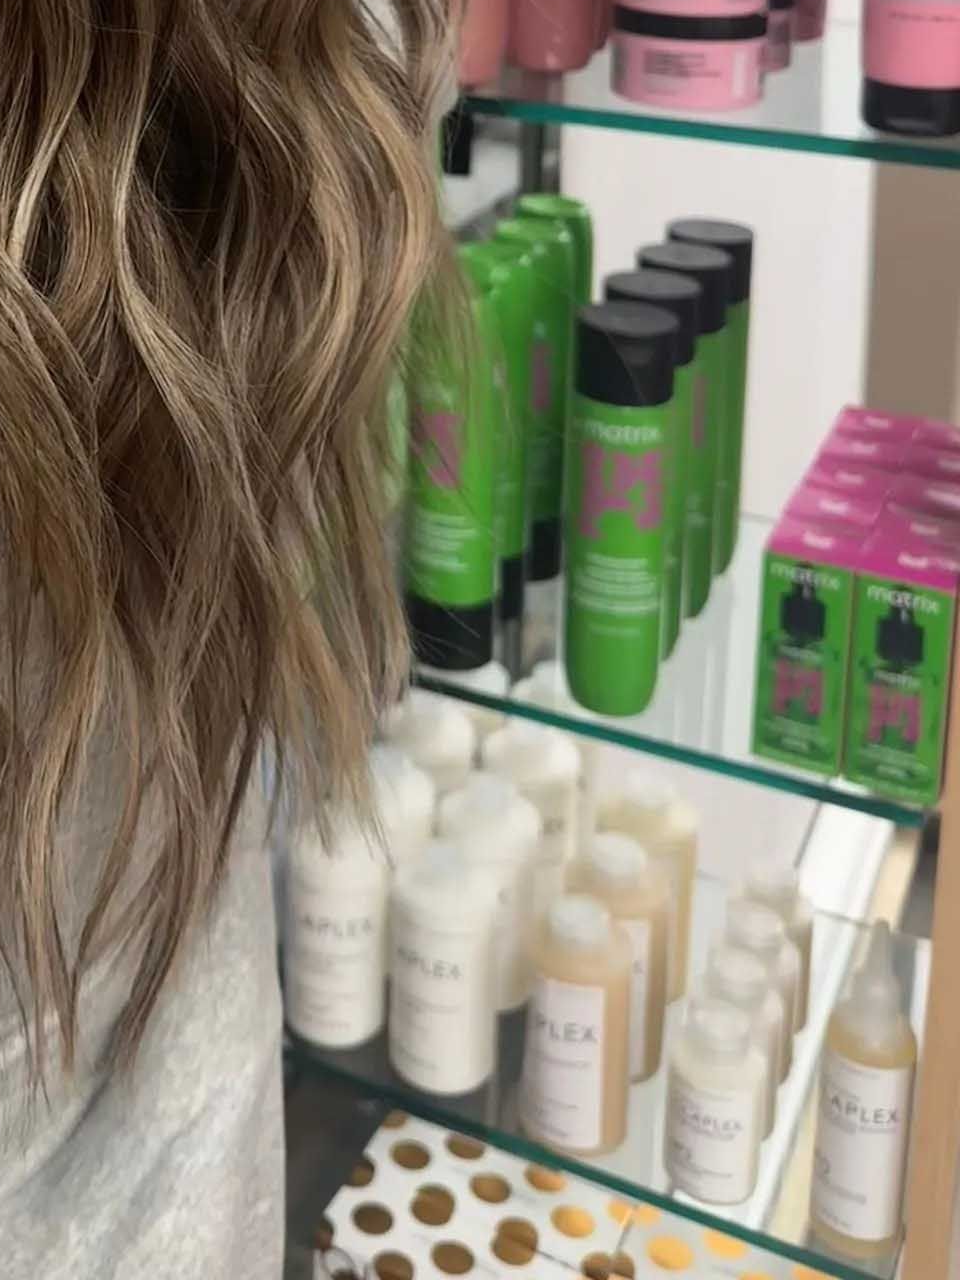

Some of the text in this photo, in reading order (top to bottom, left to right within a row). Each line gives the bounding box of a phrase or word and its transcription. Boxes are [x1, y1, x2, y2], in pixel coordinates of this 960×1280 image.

[769, 562, 841, 591] matrix
[866, 584, 940, 615] matrix
[301, 915, 372, 938] APLEX
[397, 946, 462, 981] APLEX
[533, 1012, 598, 1044] PLEX
[831, 1093, 900, 1124] APLEX
